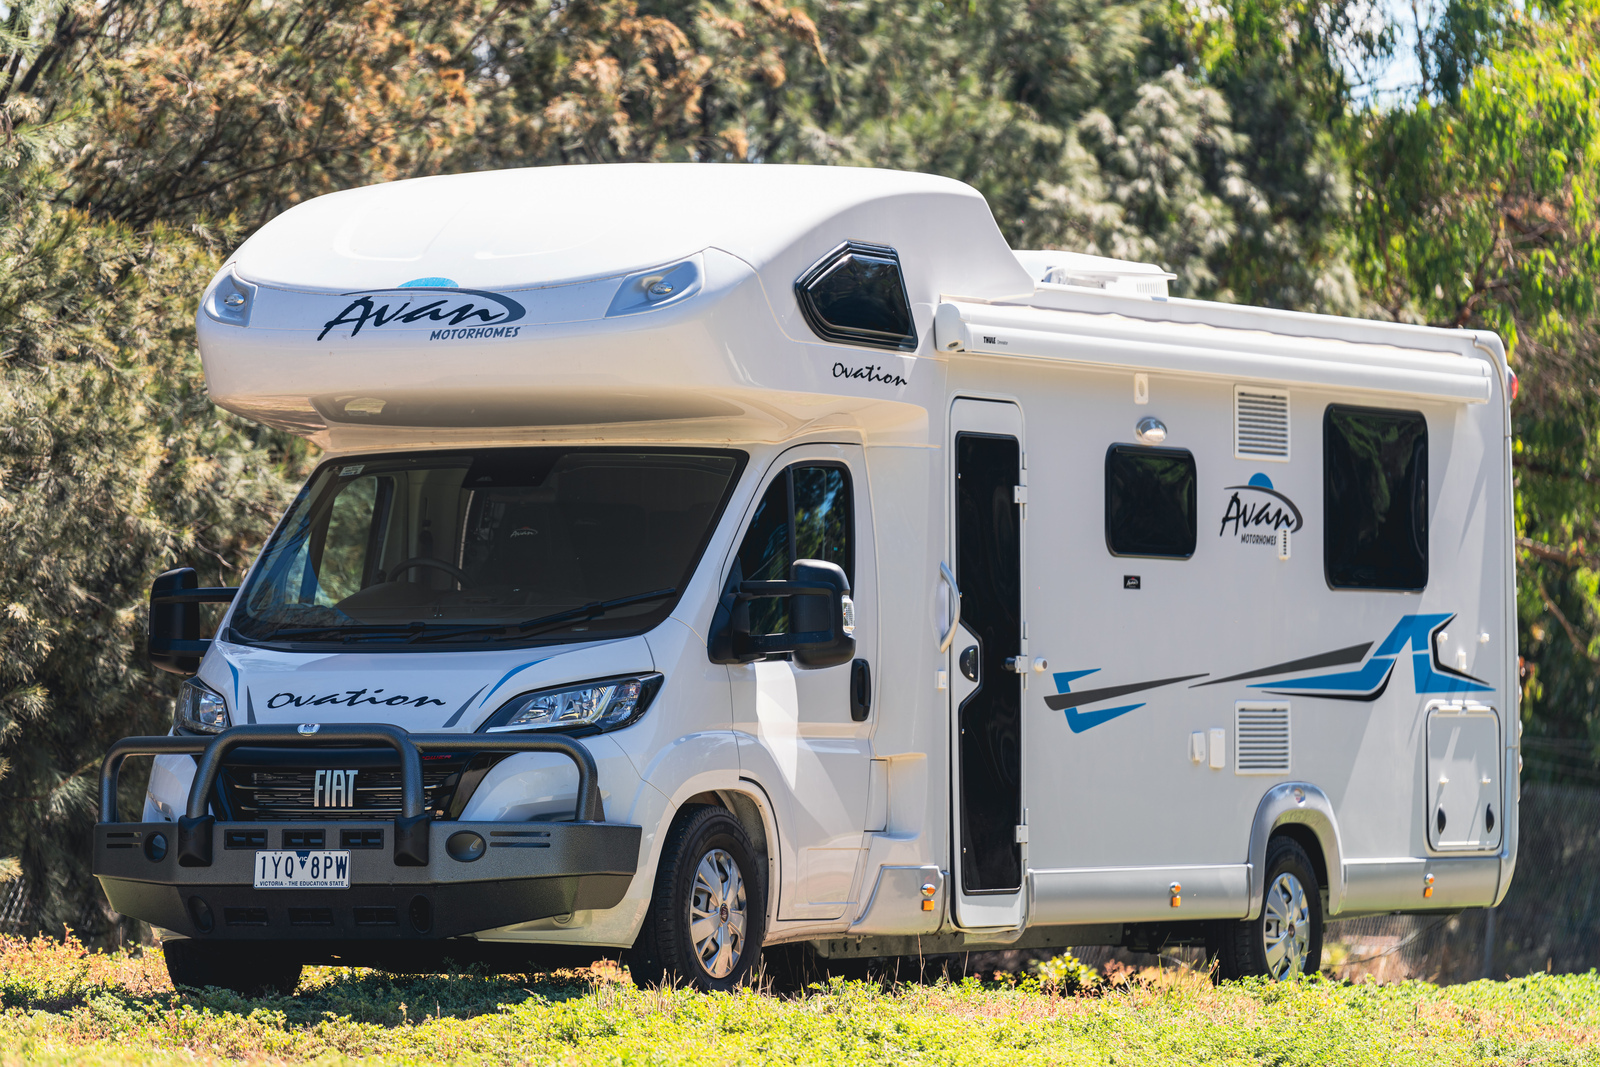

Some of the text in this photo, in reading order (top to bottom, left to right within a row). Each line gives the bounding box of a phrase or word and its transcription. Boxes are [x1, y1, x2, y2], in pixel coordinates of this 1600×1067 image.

[317, 296, 505, 341] Avan
[430, 327, 521, 341] MOTORHOMES
[832, 362, 907, 386] Ovation
[1220, 491, 1295, 537] Avan
[1241, 533, 1277, 546] MOTORHOMES
[267, 688, 446, 709] Ovation
[313, 769, 359, 807] FIAT
[261, 856, 347, 879] 1YQ 8PW
